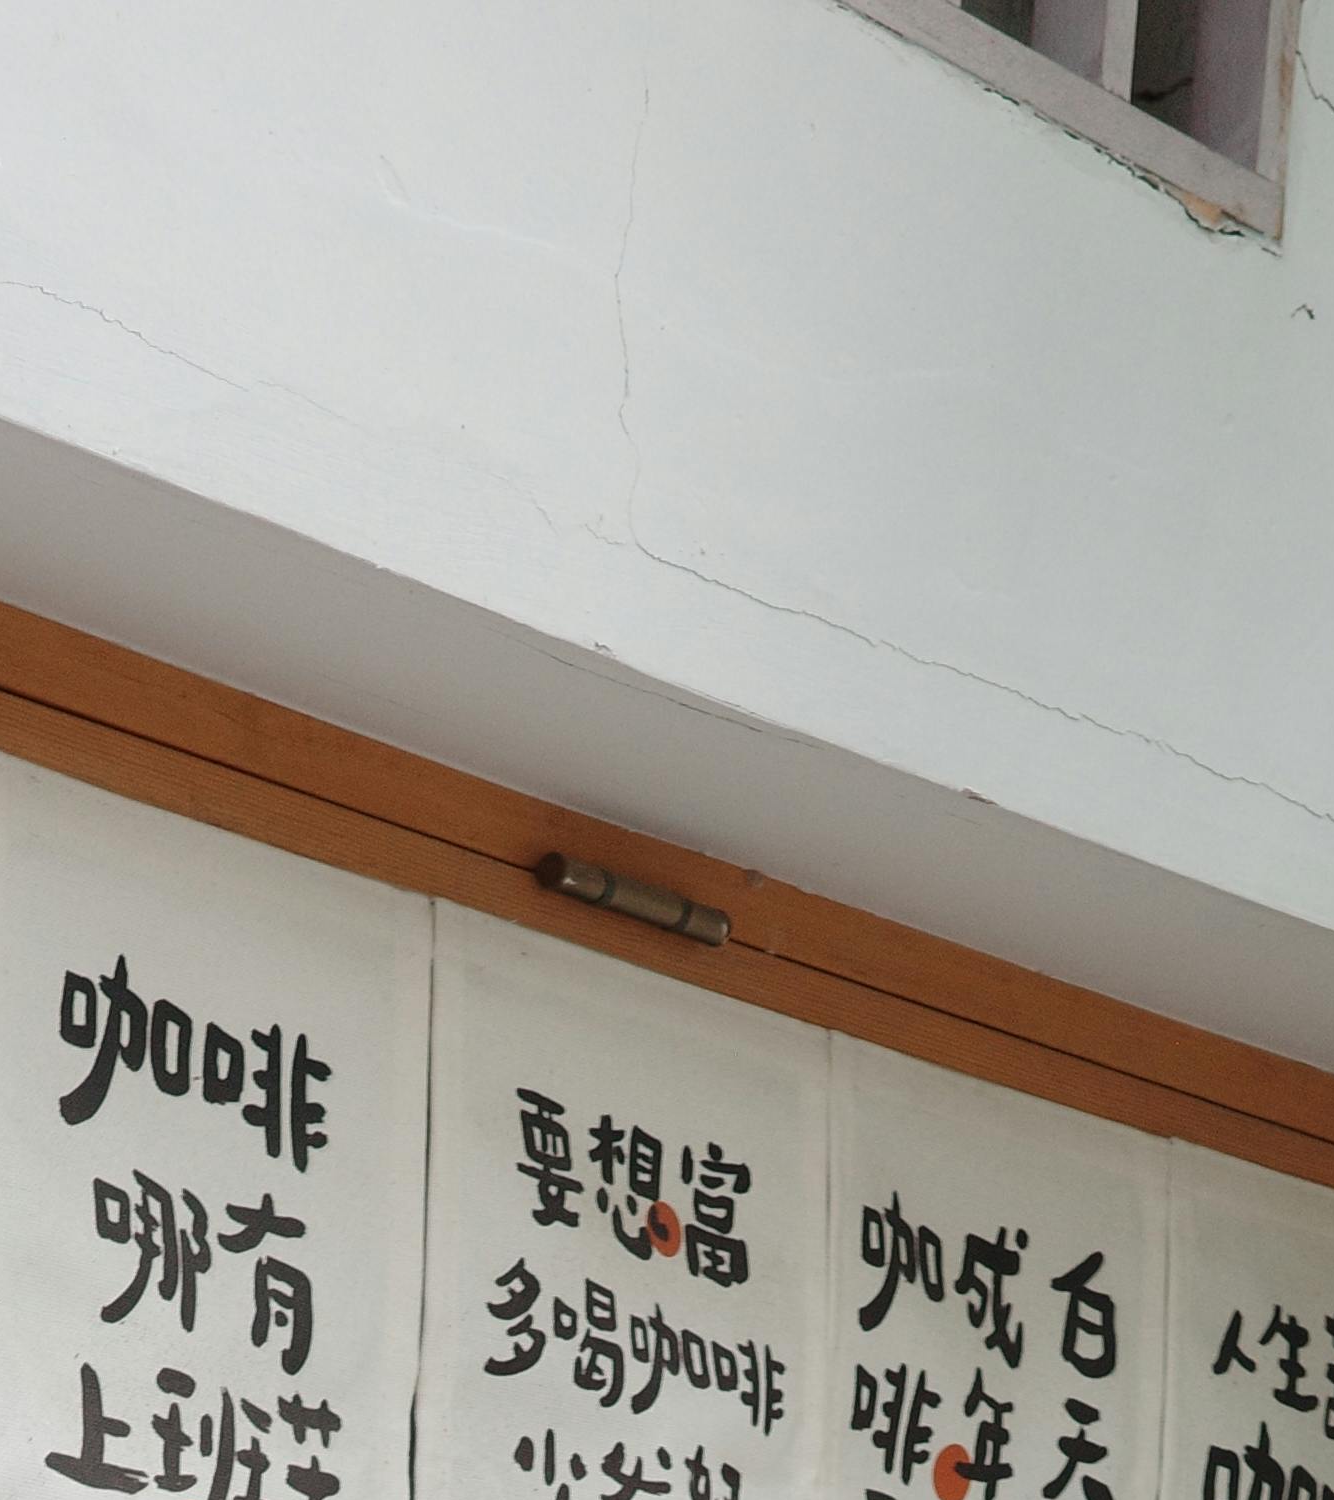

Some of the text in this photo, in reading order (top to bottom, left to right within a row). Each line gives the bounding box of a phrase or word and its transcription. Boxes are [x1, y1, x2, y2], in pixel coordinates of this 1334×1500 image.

[59, 955, 332, 1173] 咖啡
[94, 1170, 312, 1373] 哪有
[517, 1088, 751, 1287] 要想富
[484, 1258, 785, 1435] 多喝咖啡
